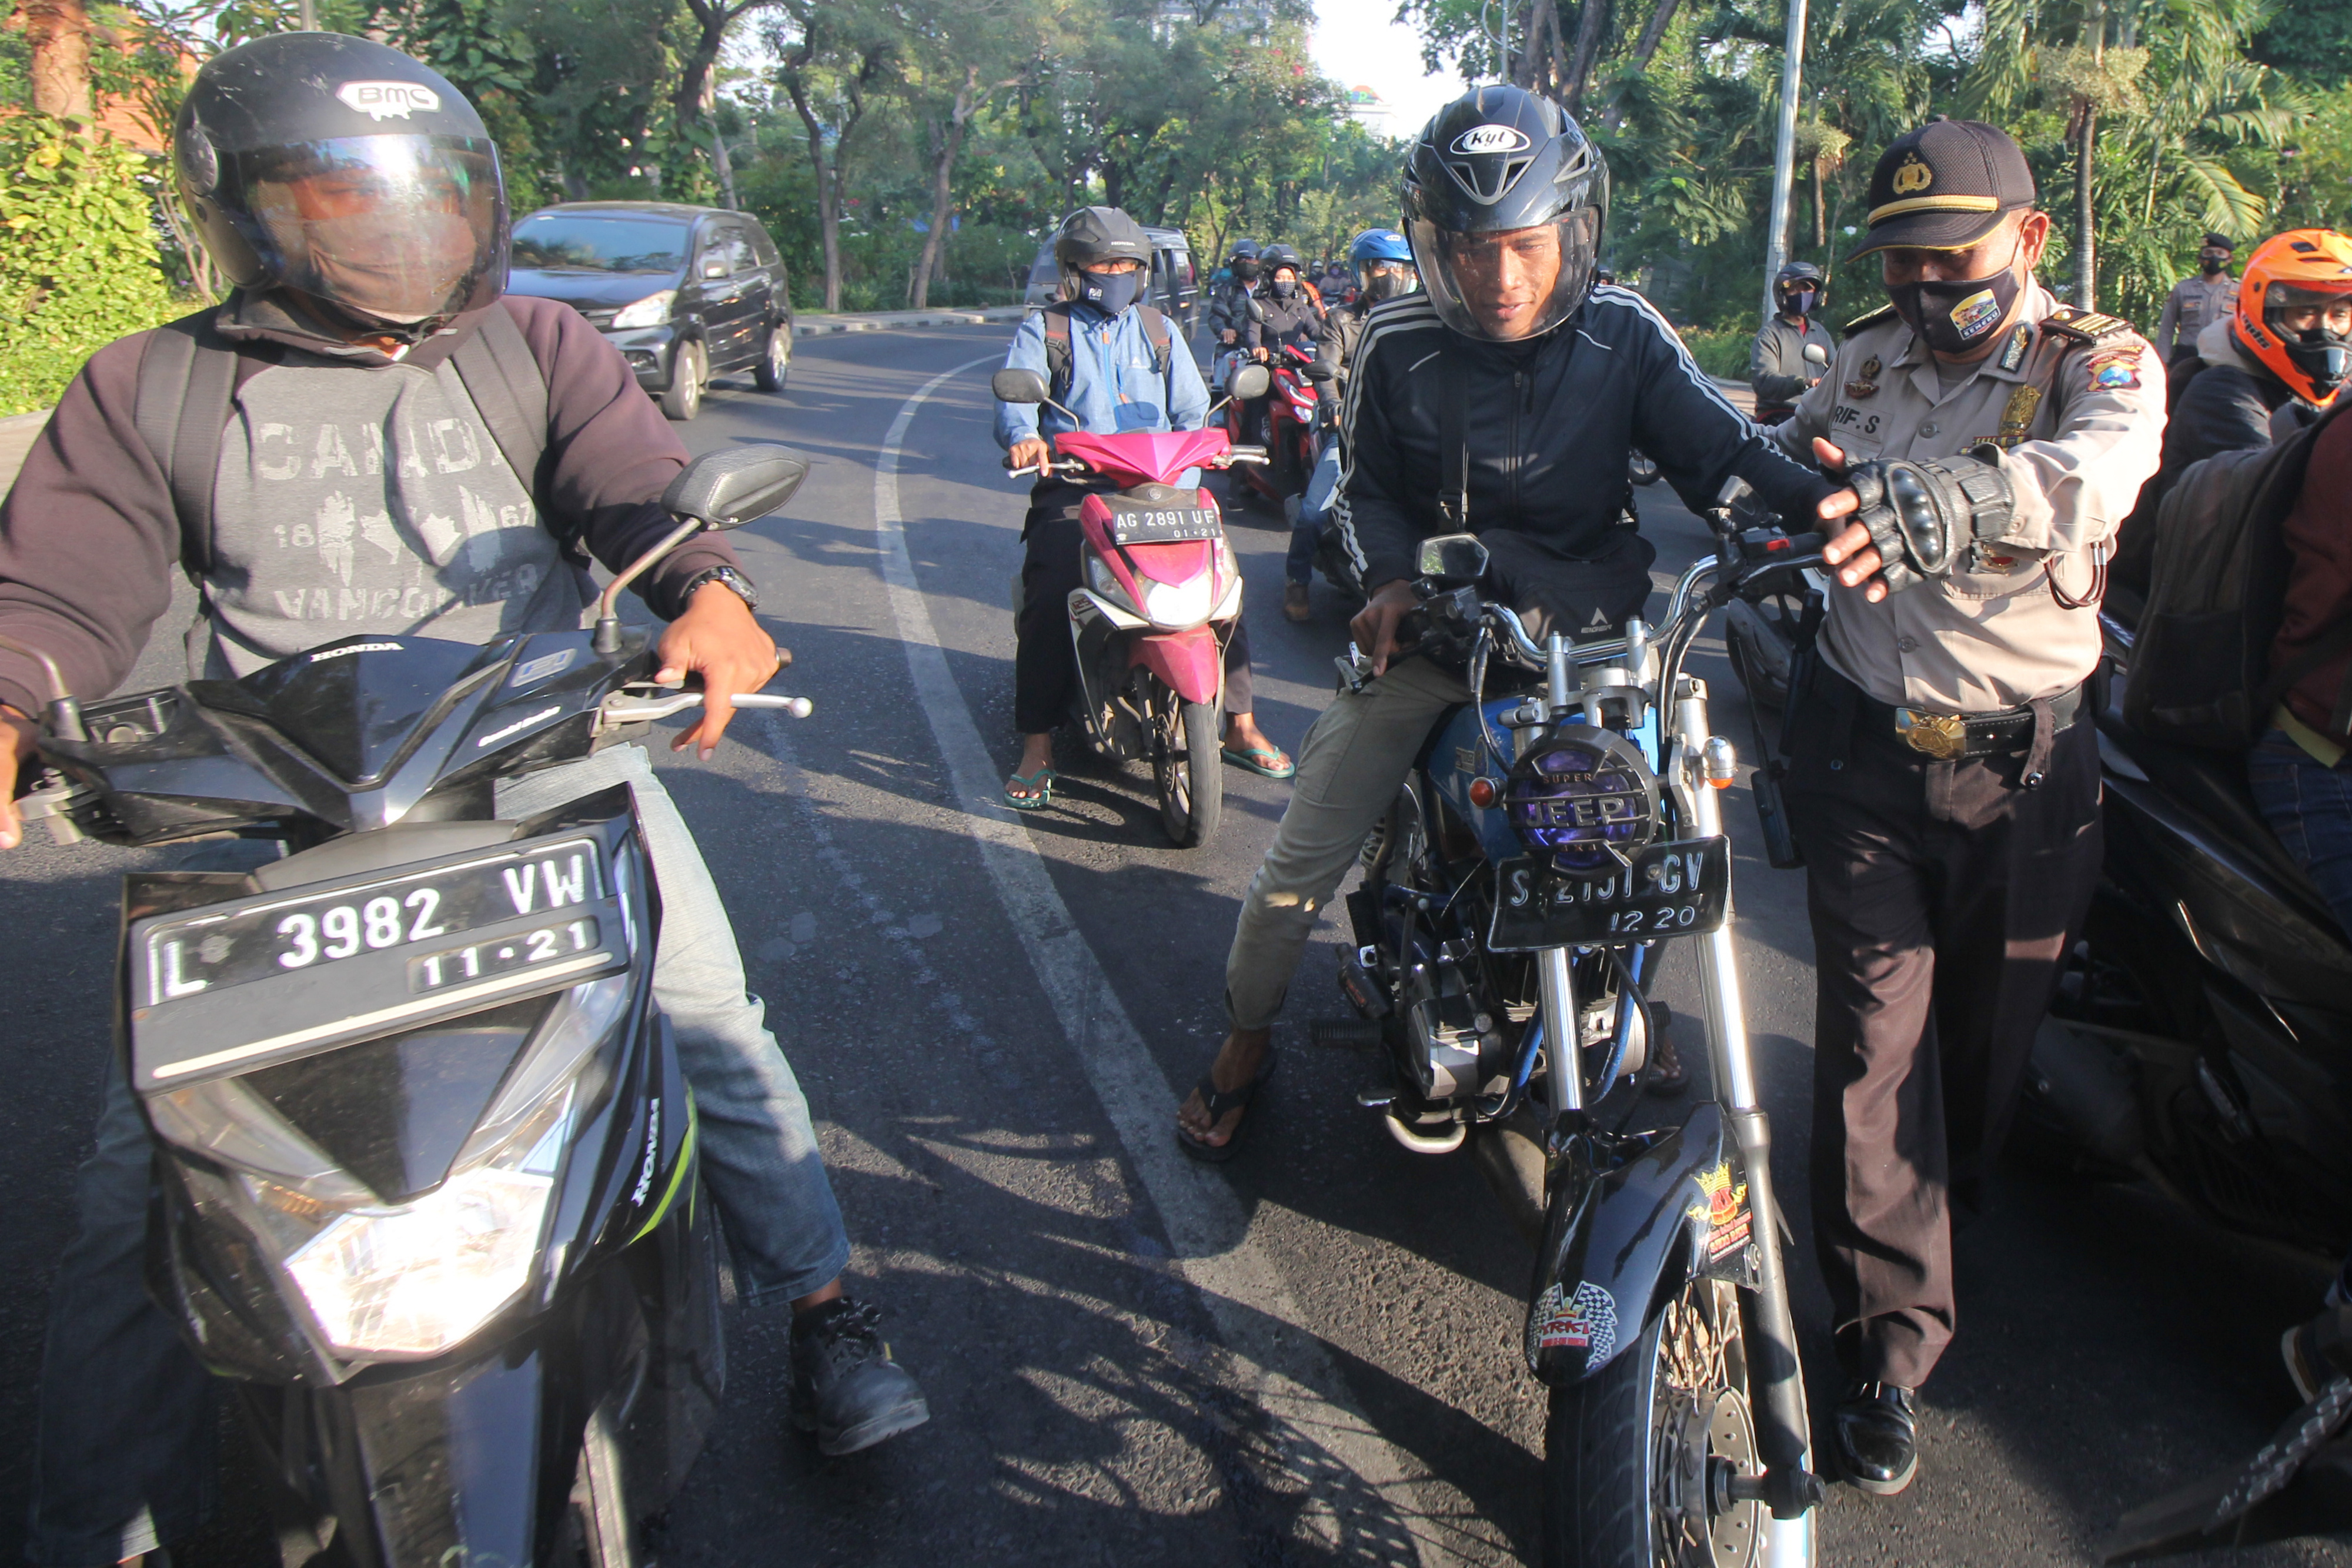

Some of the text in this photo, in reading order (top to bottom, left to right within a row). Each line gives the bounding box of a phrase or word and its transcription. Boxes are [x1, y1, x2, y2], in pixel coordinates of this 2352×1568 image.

[256, 417, 505, 480] CANAD
[1117, 509, 1215, 529] AG 2891 UF
[1581, 624, 1613, 634] EIGER
[310, 641, 405, 663] HONDA
[1543, 773, 1592, 784] SUPER
[1526, 797, 1625, 828] JEEP
[1509, 869, 1529, 907] S
[1658, 852, 1704, 894] GV
[163, 854, 587, 998] L 3982 VW
[1610, 905, 1696, 932] 12 20
